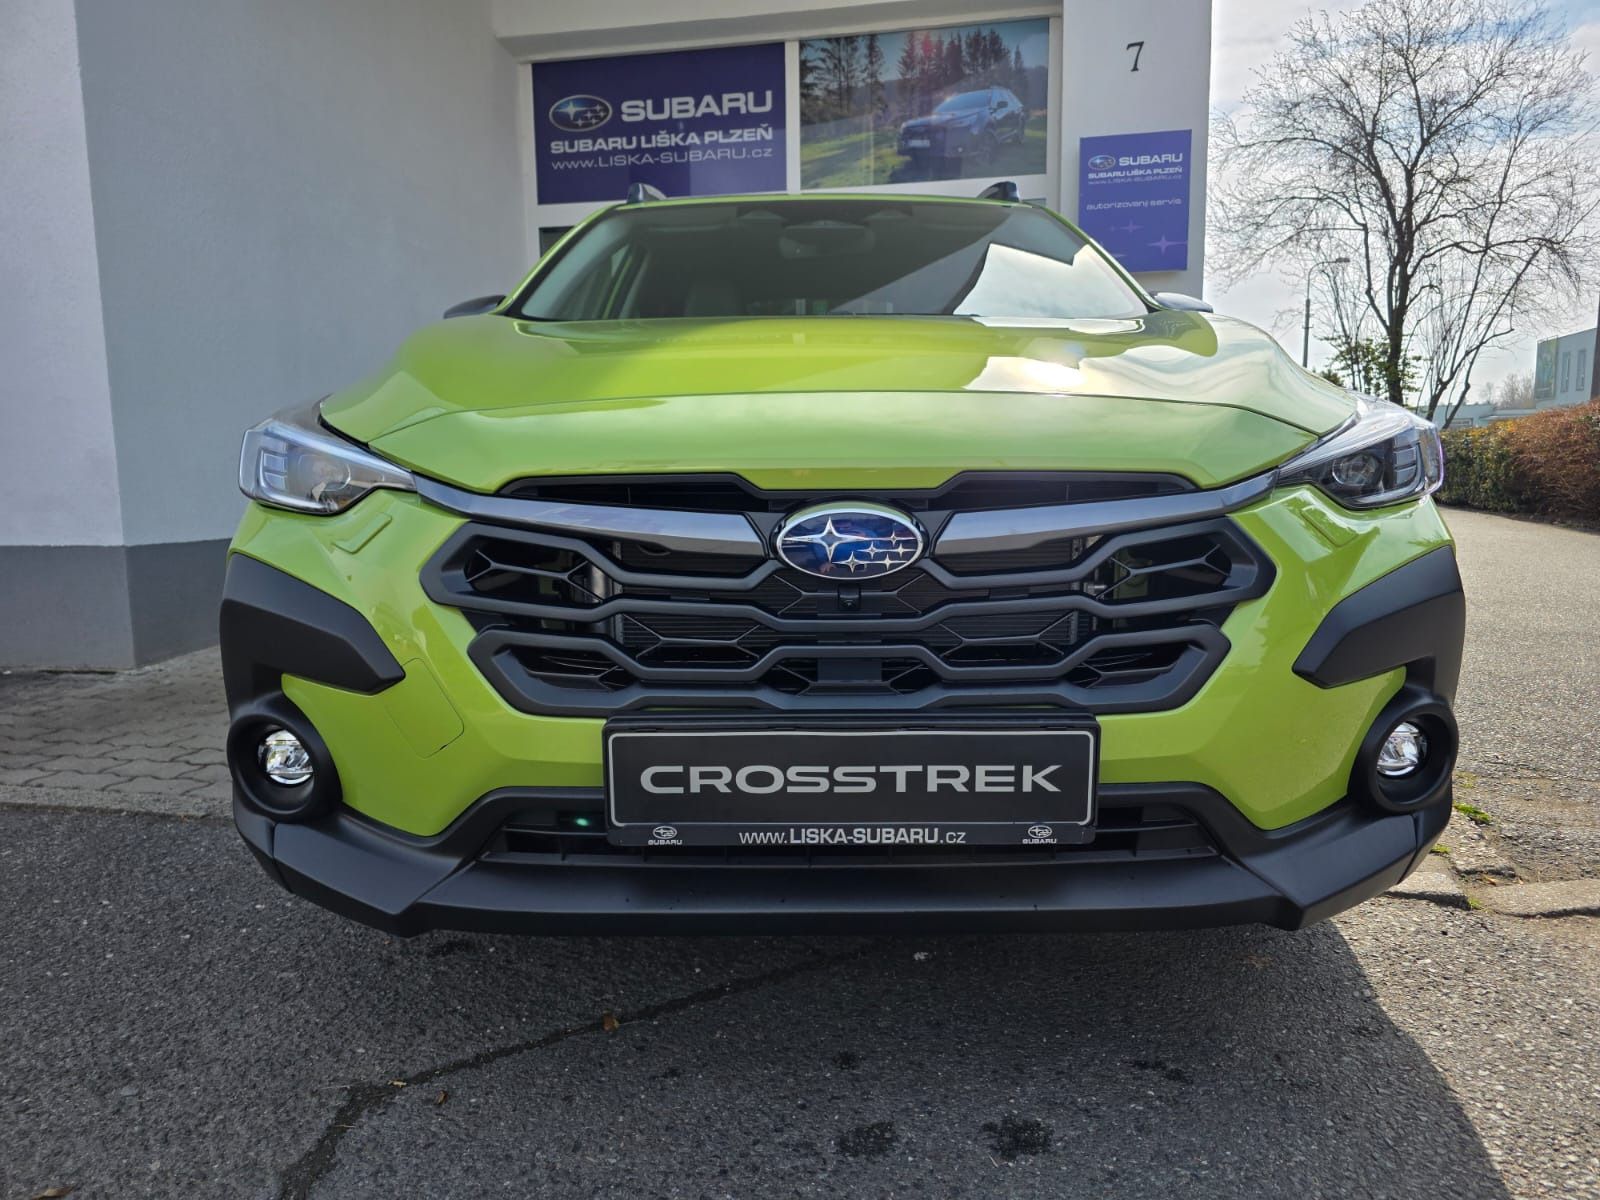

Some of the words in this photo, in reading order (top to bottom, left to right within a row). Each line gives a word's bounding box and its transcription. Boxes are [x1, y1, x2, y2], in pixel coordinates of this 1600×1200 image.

[1126, 41, 1145, 72] 7
[621, 90, 773, 122] SUBARU
[550, 136, 637, 154] SUBARU
[641, 130, 701, 148] LIŠKA
[704, 123, 773, 144] PLZEŇ
[551, 148, 773, 170] www.LISKA-SUBARU.cz
[1119, 153, 1183, 166] SUBARU
[1088, 170, 1125, 179] SUBARU
[640, 764, 1062, 795] CROSSTREK
[738, 827, 967, 845] www.LISKA-SUBARU.cz
